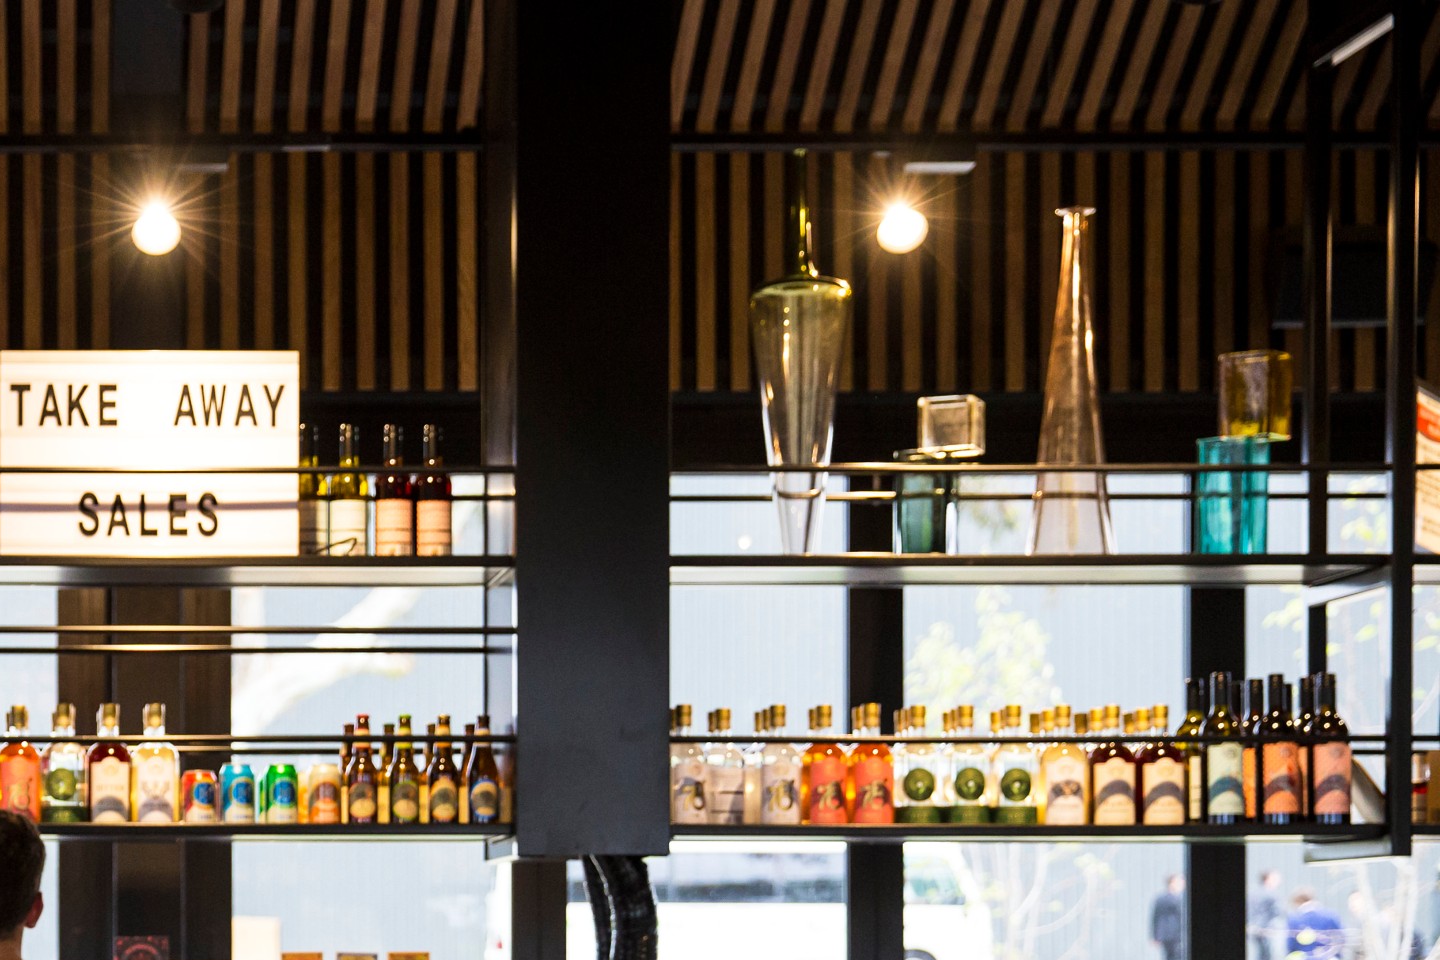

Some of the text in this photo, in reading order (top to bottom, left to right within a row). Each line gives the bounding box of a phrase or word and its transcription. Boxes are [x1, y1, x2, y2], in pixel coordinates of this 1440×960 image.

[10, 384, 285, 428] TAKE AWAY
[78, 492, 218, 537] SALES
